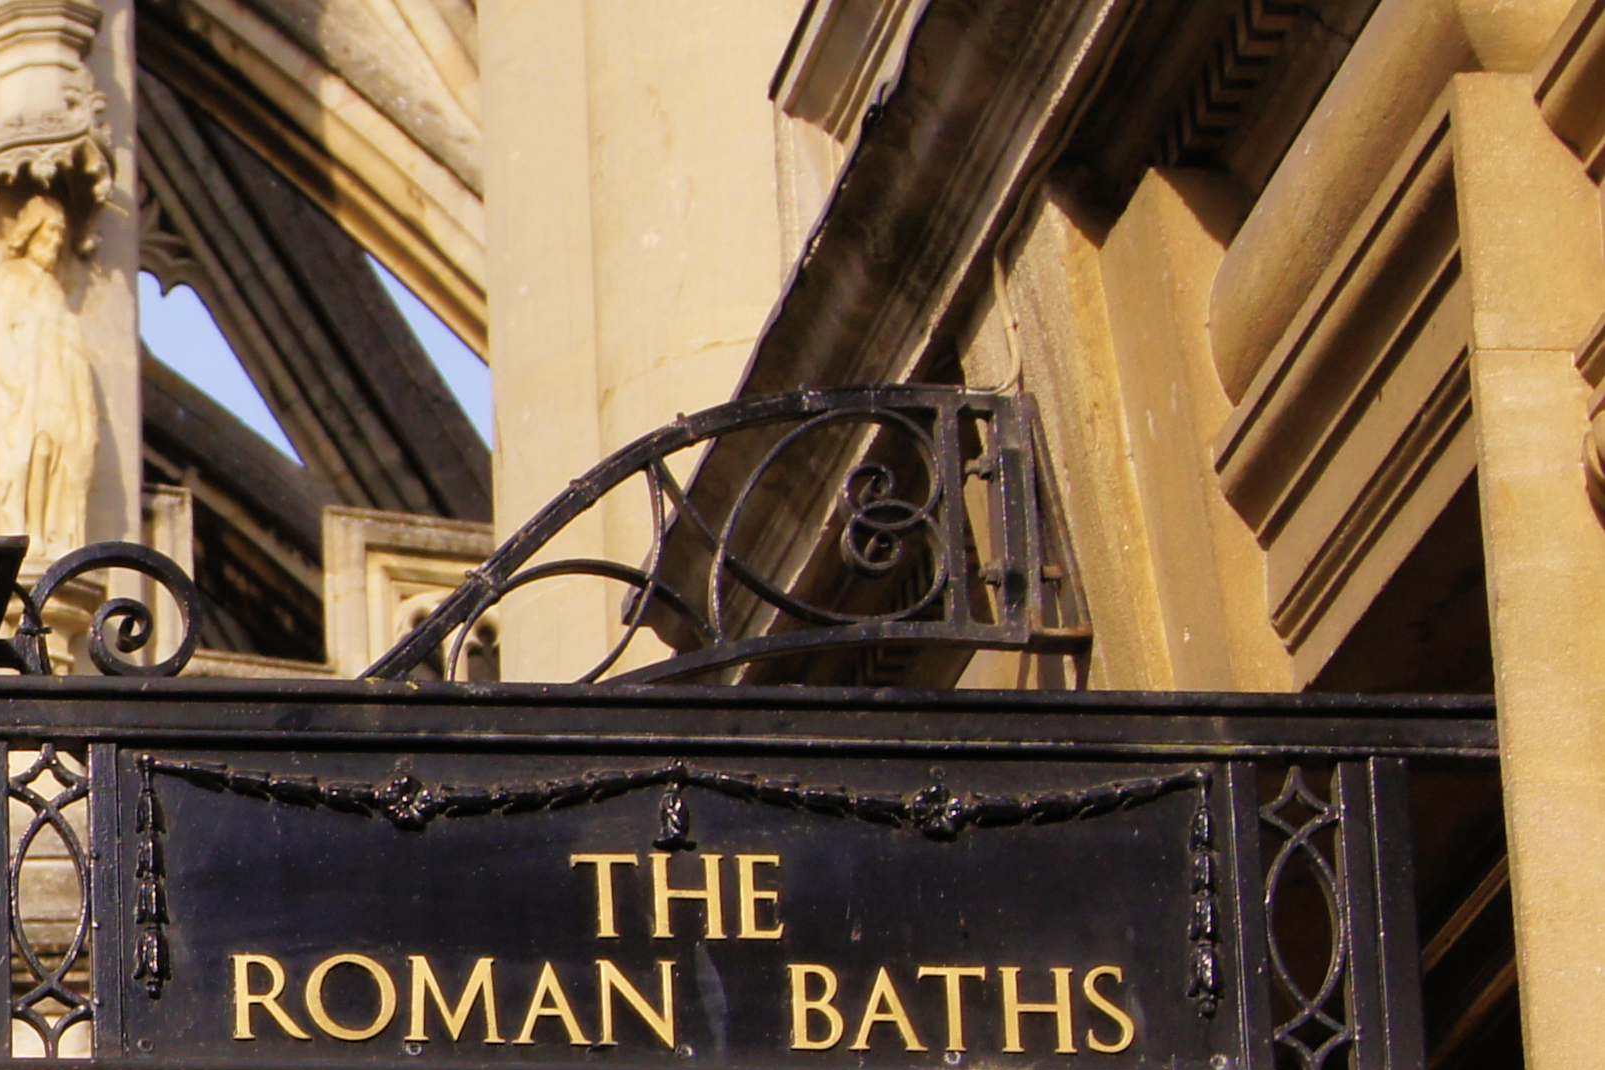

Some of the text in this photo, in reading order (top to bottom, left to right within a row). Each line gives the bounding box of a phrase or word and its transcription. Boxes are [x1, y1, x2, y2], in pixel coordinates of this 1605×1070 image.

[568, 851, 786, 941] THE
[228, 951, 1138, 1057] ROMAN BATHS
